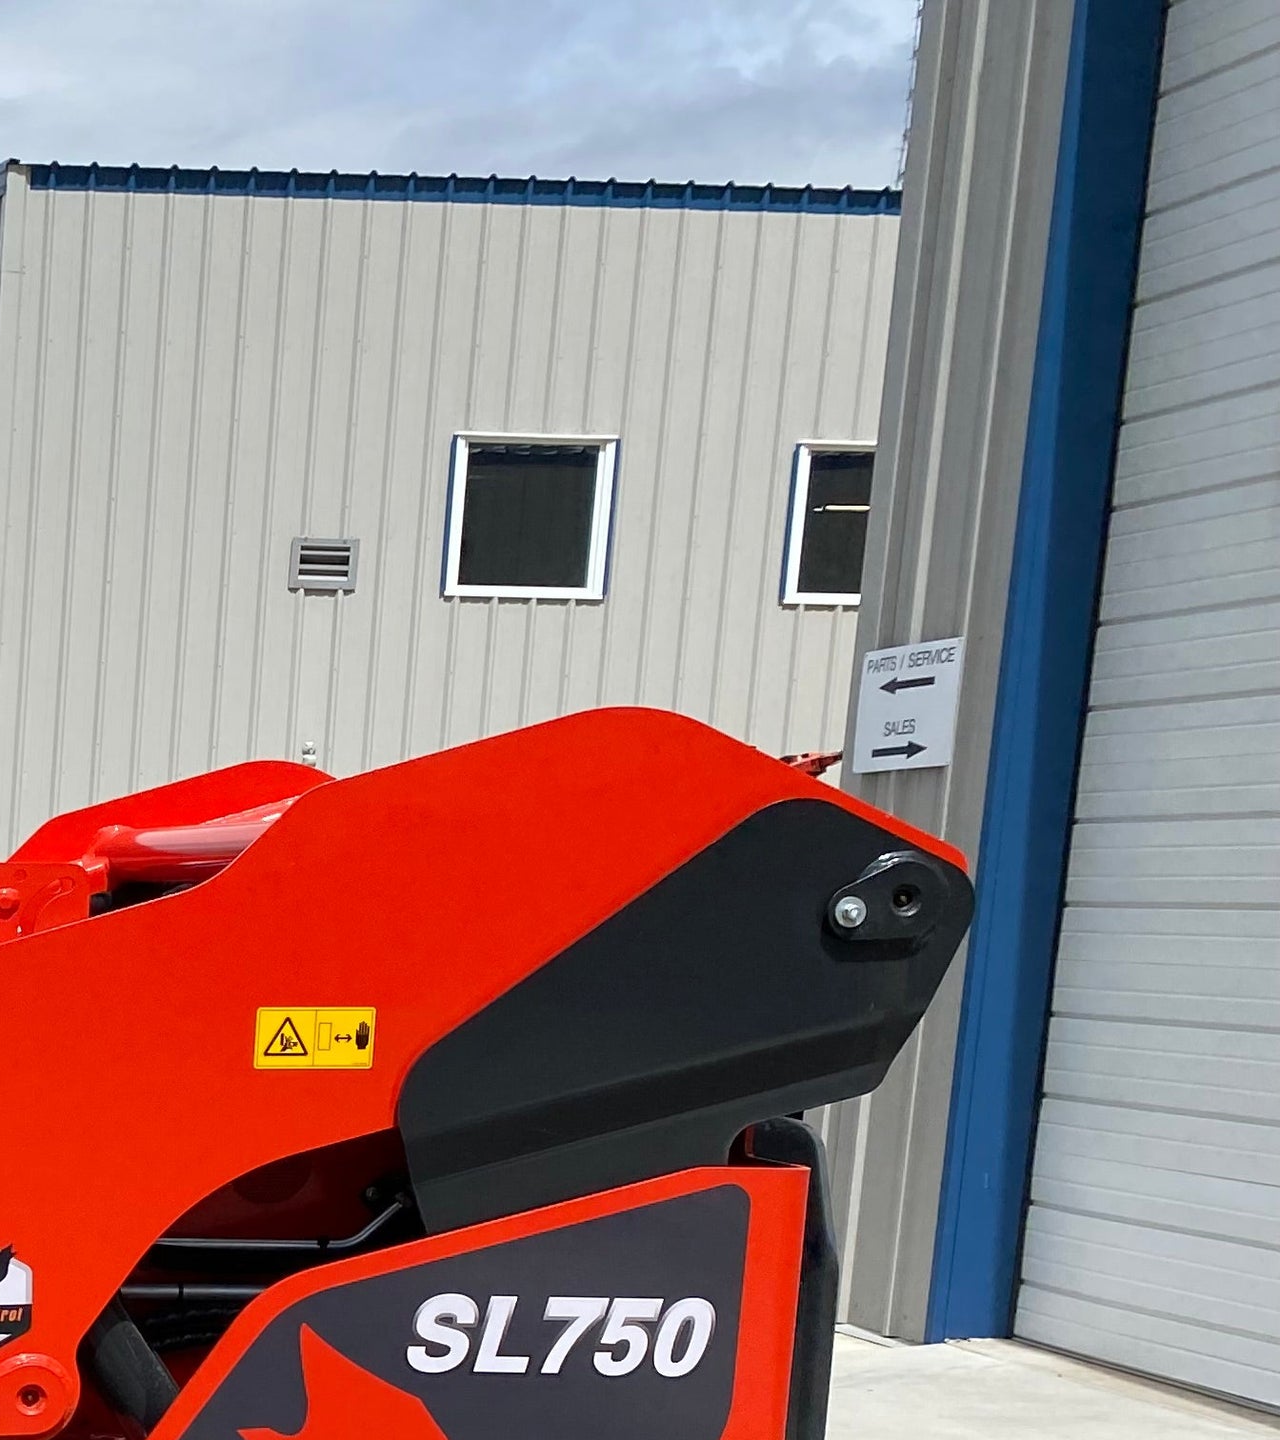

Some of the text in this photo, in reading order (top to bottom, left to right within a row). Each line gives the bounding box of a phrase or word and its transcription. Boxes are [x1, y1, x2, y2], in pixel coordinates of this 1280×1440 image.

[867, 655, 897, 674] PARTS
[907, 646, 957, 669] SERVICE
[883, 719, 917, 737] SALES
[406, 1293, 717, 1378] SL750
